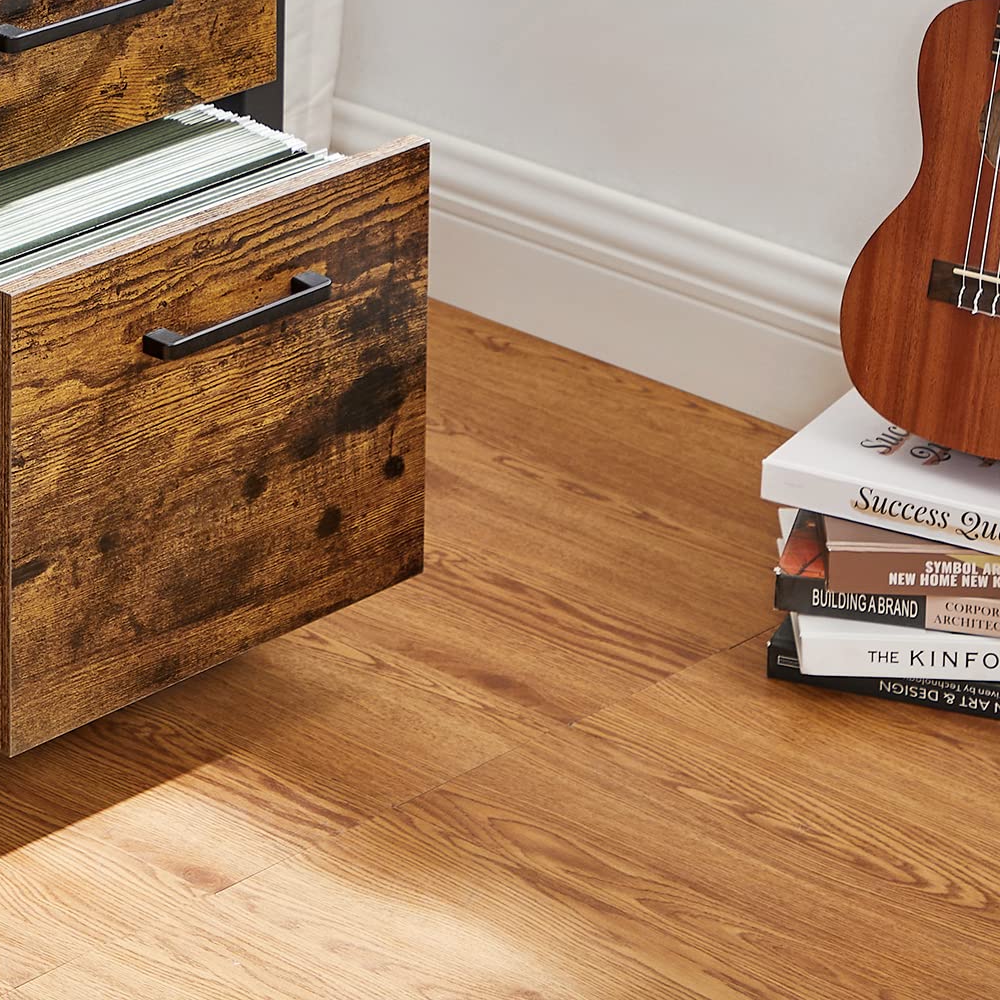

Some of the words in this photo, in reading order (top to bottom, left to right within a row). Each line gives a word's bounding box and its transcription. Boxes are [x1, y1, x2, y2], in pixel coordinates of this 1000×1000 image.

[854, 486, 950, 529] Success
[925, 560, 979, 575] SYMBOL
[889, 572, 916, 586] NEW
[920, 574, 958, 587] HOME
[962, 574, 988, 588] NEW
[868, 650, 900, 664] THE
[910, 650, 1000, 670] KINFO
[879, 680, 938, 702] DESIGN
[963, 684, 976, 695] by
[943, 692, 956, 704] &
[960, 695, 990, 711] ART
